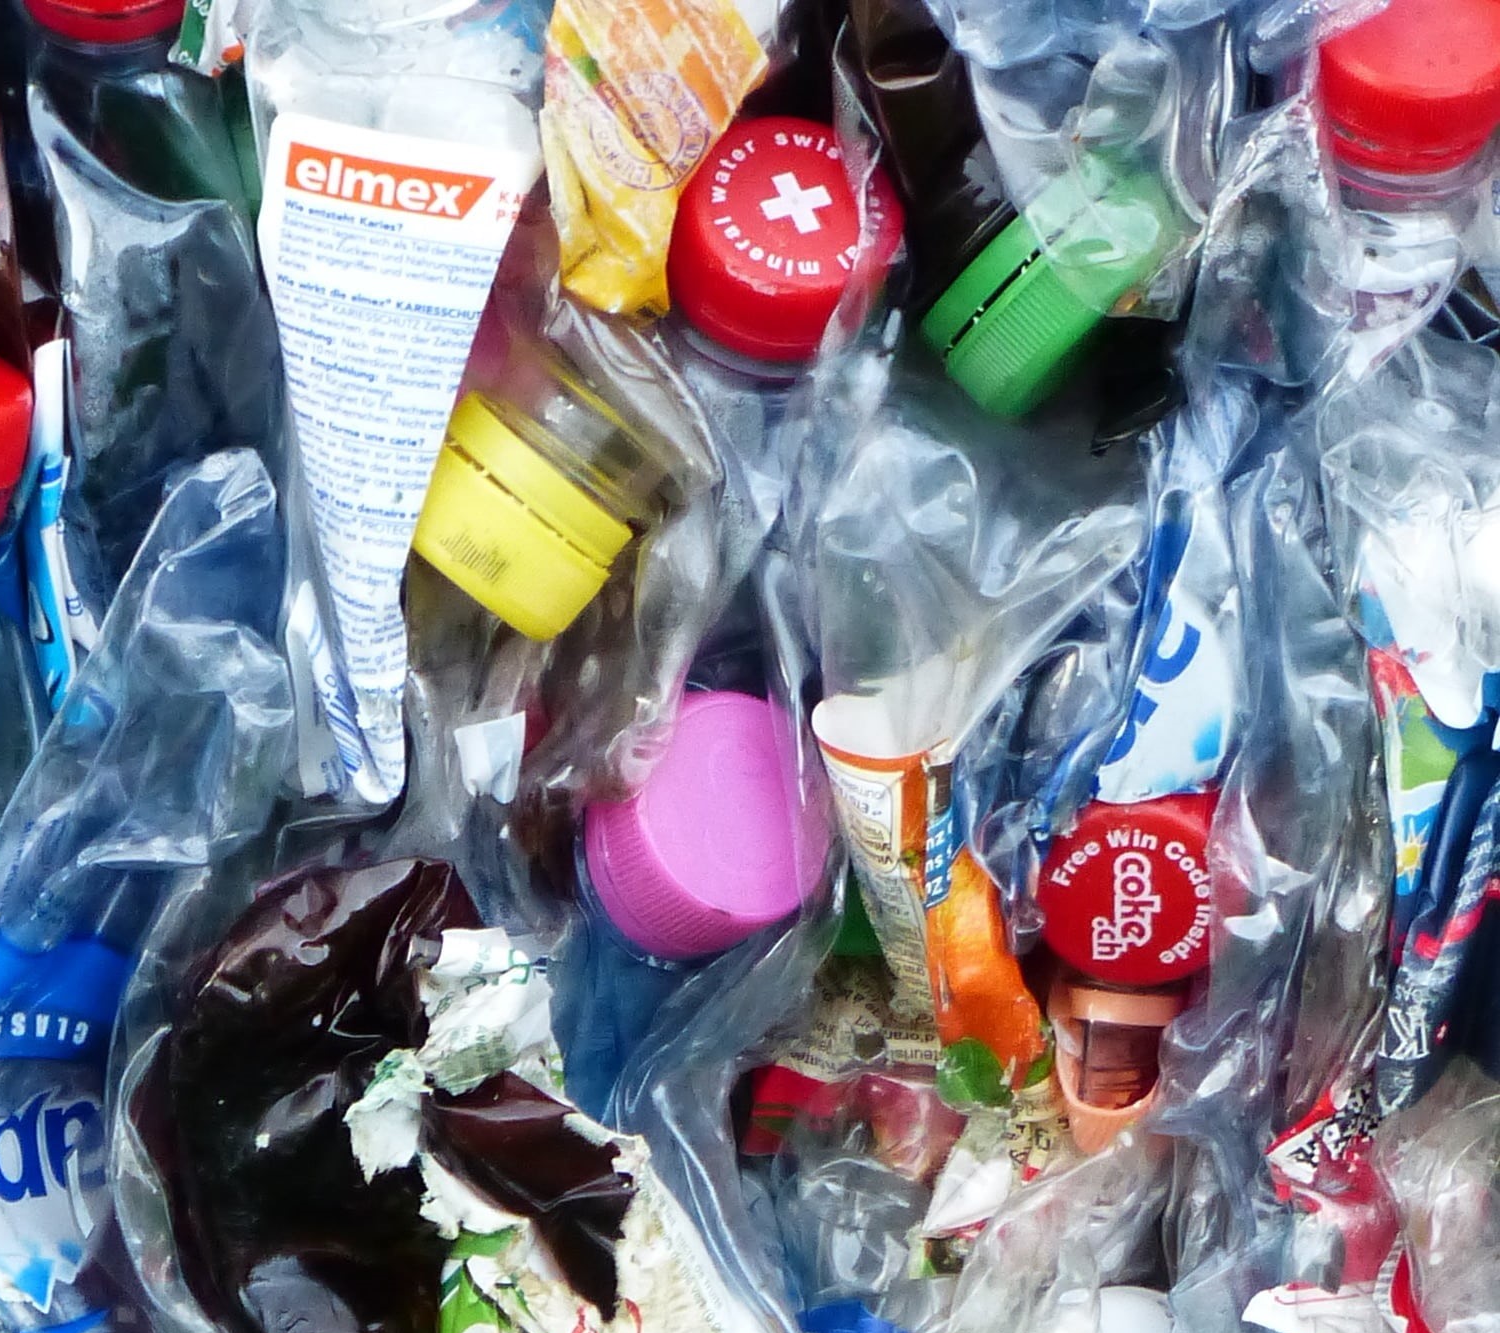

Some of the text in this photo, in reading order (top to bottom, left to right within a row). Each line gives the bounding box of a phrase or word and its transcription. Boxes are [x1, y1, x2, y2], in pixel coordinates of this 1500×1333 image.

[294, 156, 462, 217] elmex
[710, 140, 756, 204] water
[713, 216, 820, 278] mineral
[1050, 841, 1102, 888] Free
[1106, 828, 1159, 852] Win
[1164, 841, 1212, 900] Code
